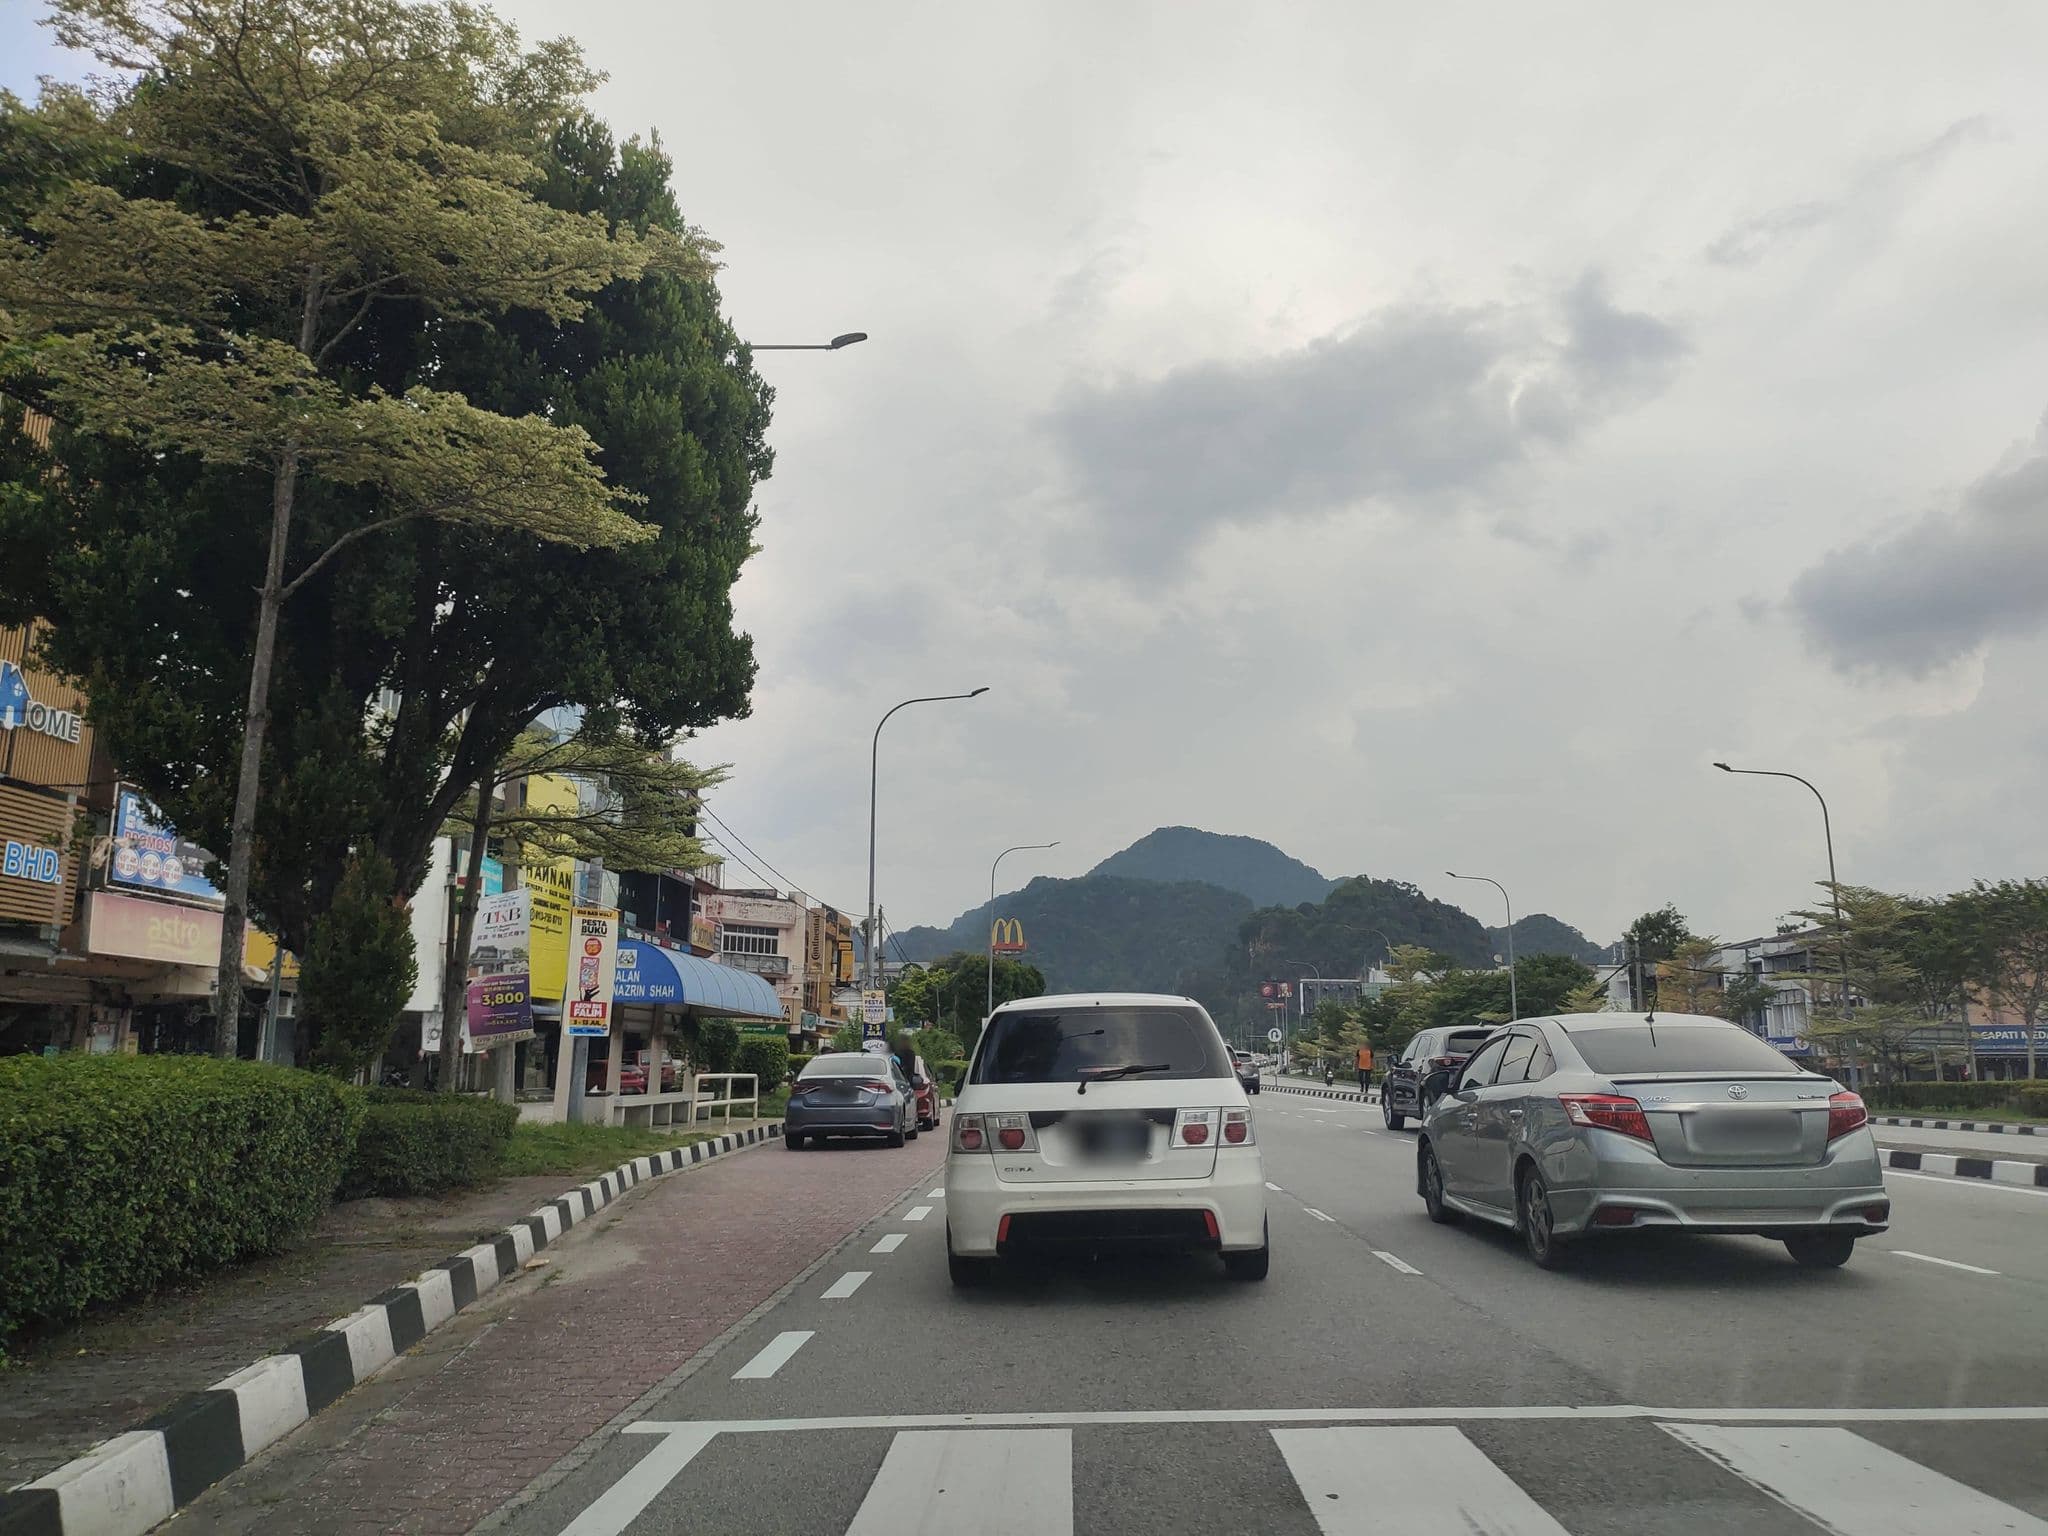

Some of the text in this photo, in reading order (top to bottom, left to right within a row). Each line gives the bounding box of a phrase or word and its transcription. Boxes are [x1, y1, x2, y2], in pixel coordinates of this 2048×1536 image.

[3, 840, 62, 884] BHD.
[581, 918, 607, 927] PESTA
[149, 915, 201, 946] astro
[581, 926, 608, 935] BUKU
[811, 912, 821, 961] Continental
[615, 969, 641, 983] ALAN
[649, 985, 675, 998] SHAH
[481, 991, 525, 1007] 3,800
[573, 1008, 603, 1018] FALIM
